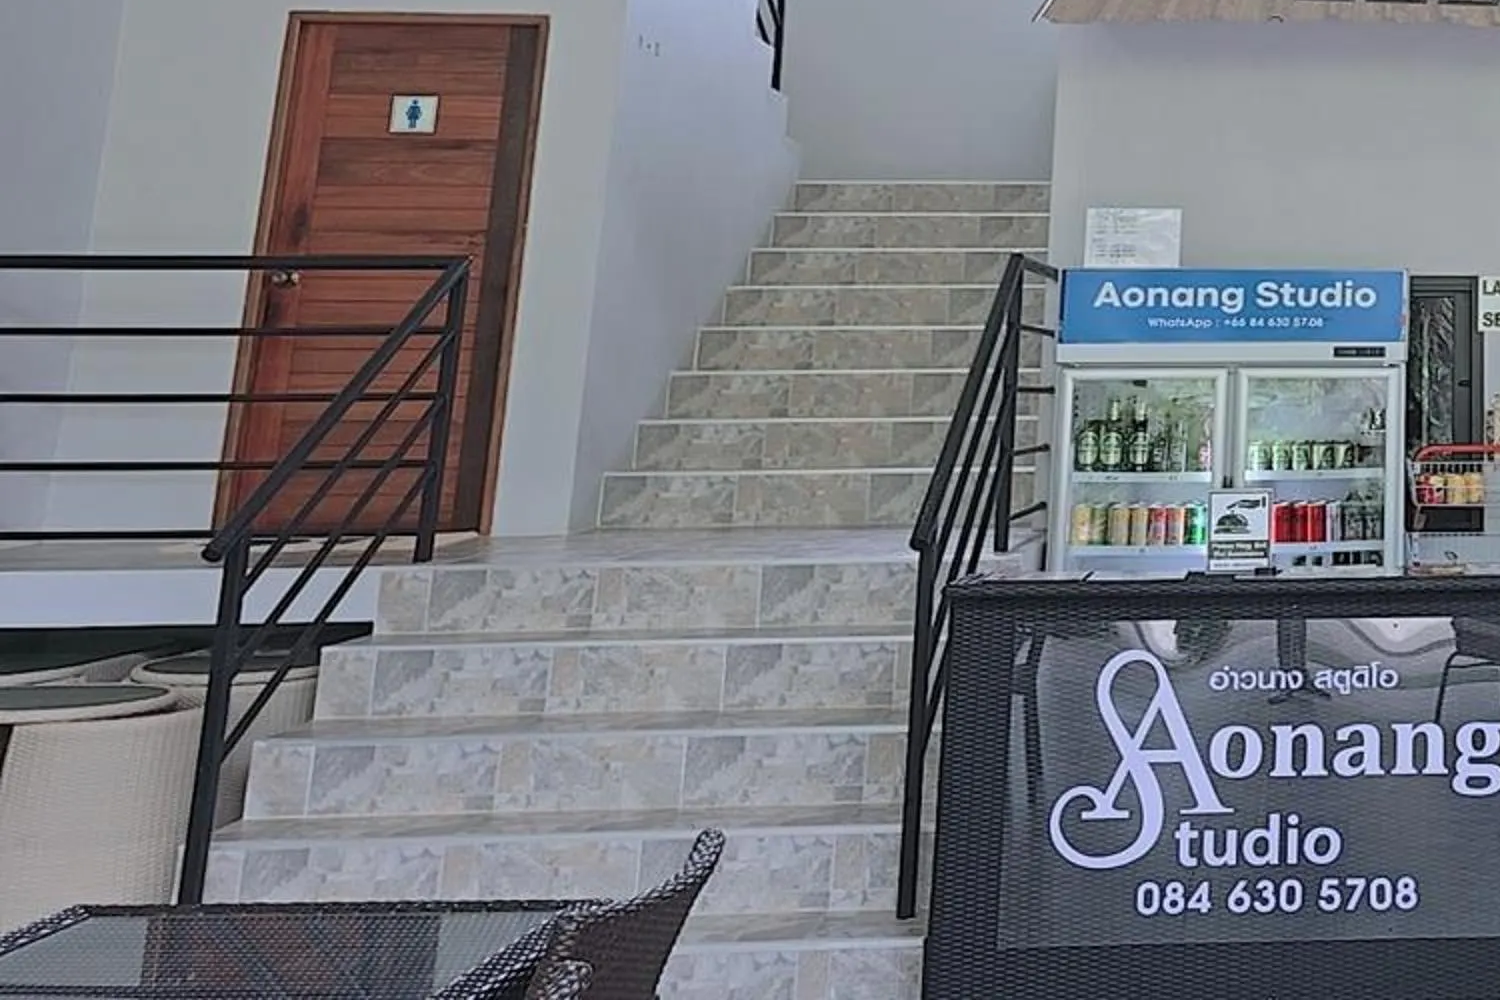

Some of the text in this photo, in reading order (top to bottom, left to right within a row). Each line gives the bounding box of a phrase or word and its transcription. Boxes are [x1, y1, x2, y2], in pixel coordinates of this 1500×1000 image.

[1093, 280, 1377, 314] Aonang Studio
[1147, 316, 1213, 329] WhatsApp
[1209, 661, 1400, 694] อ่าวนาง สตูดิโอ
[1136, 876, 1419, 916] 084 630 5708
